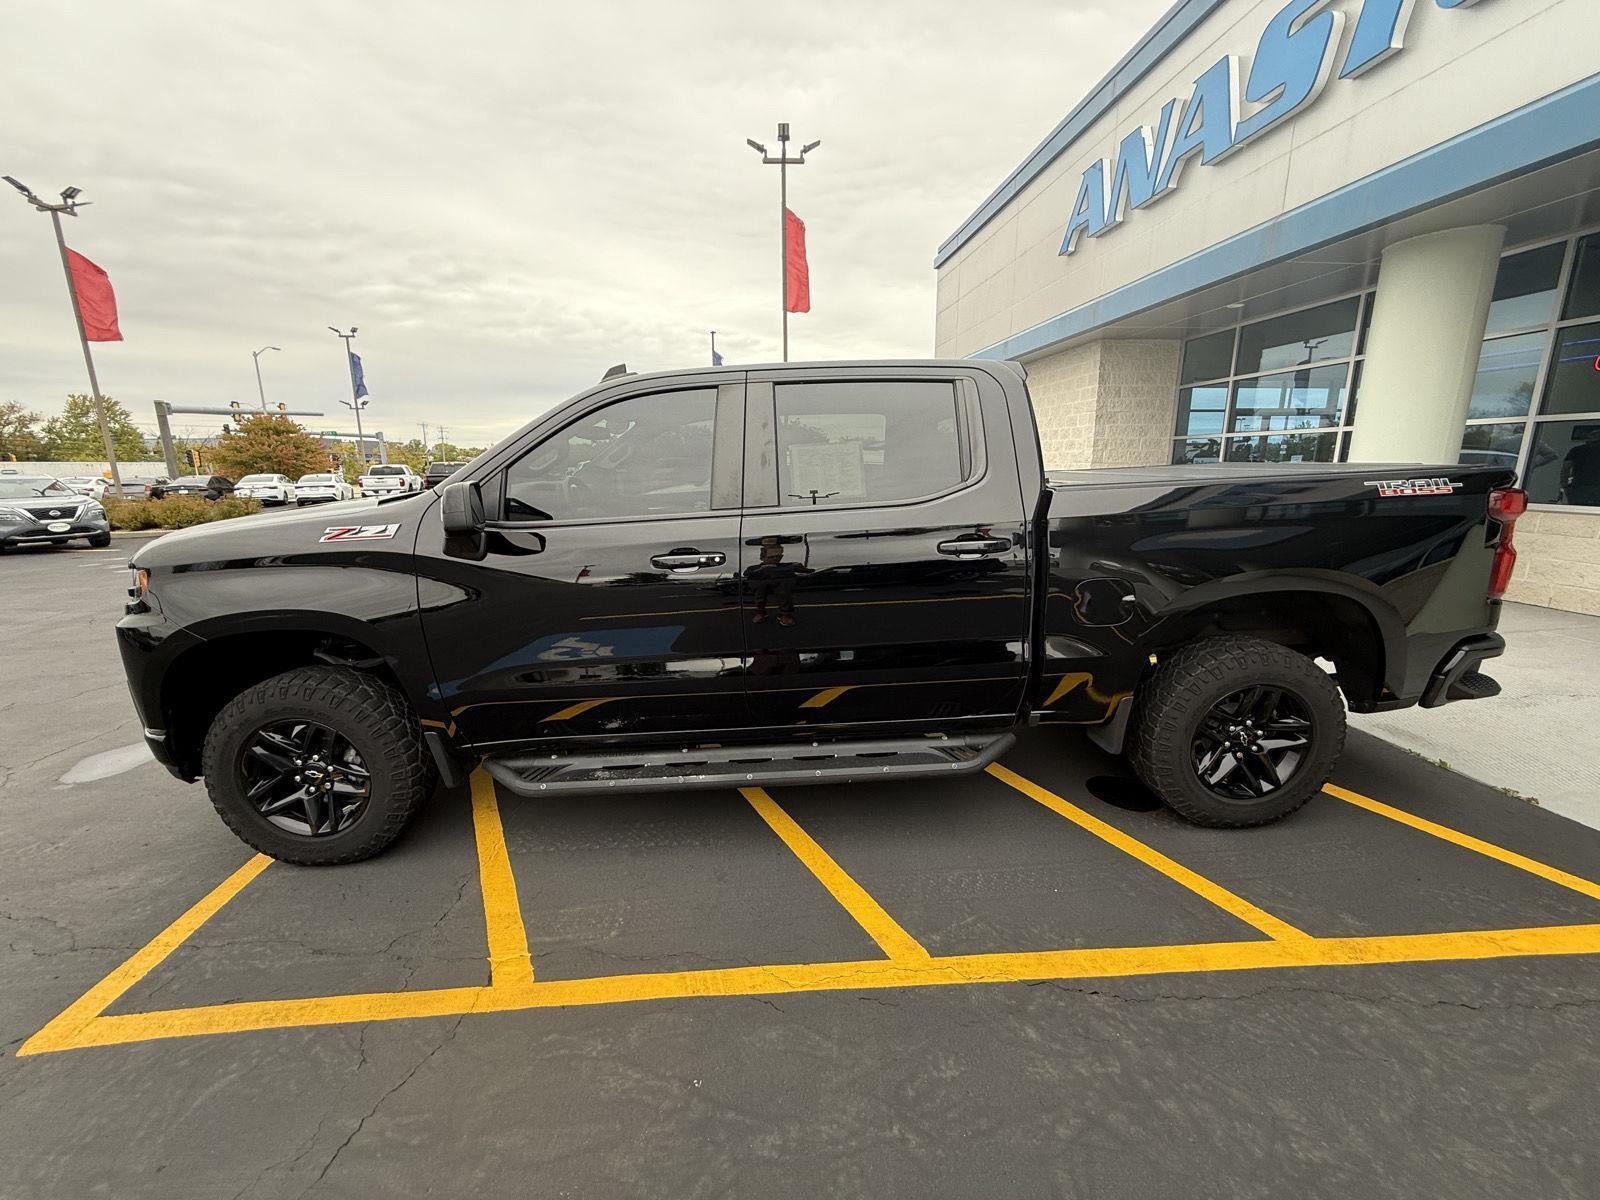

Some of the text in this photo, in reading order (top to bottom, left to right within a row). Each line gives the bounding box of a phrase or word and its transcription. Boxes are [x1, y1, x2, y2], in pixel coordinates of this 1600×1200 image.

[1059, 0, 1480, 256] ANAS
[1363, 478, 1463, 490] TRAIL
[1379, 486, 1453, 497] BOSS
[319, 523, 402, 543] Z71
